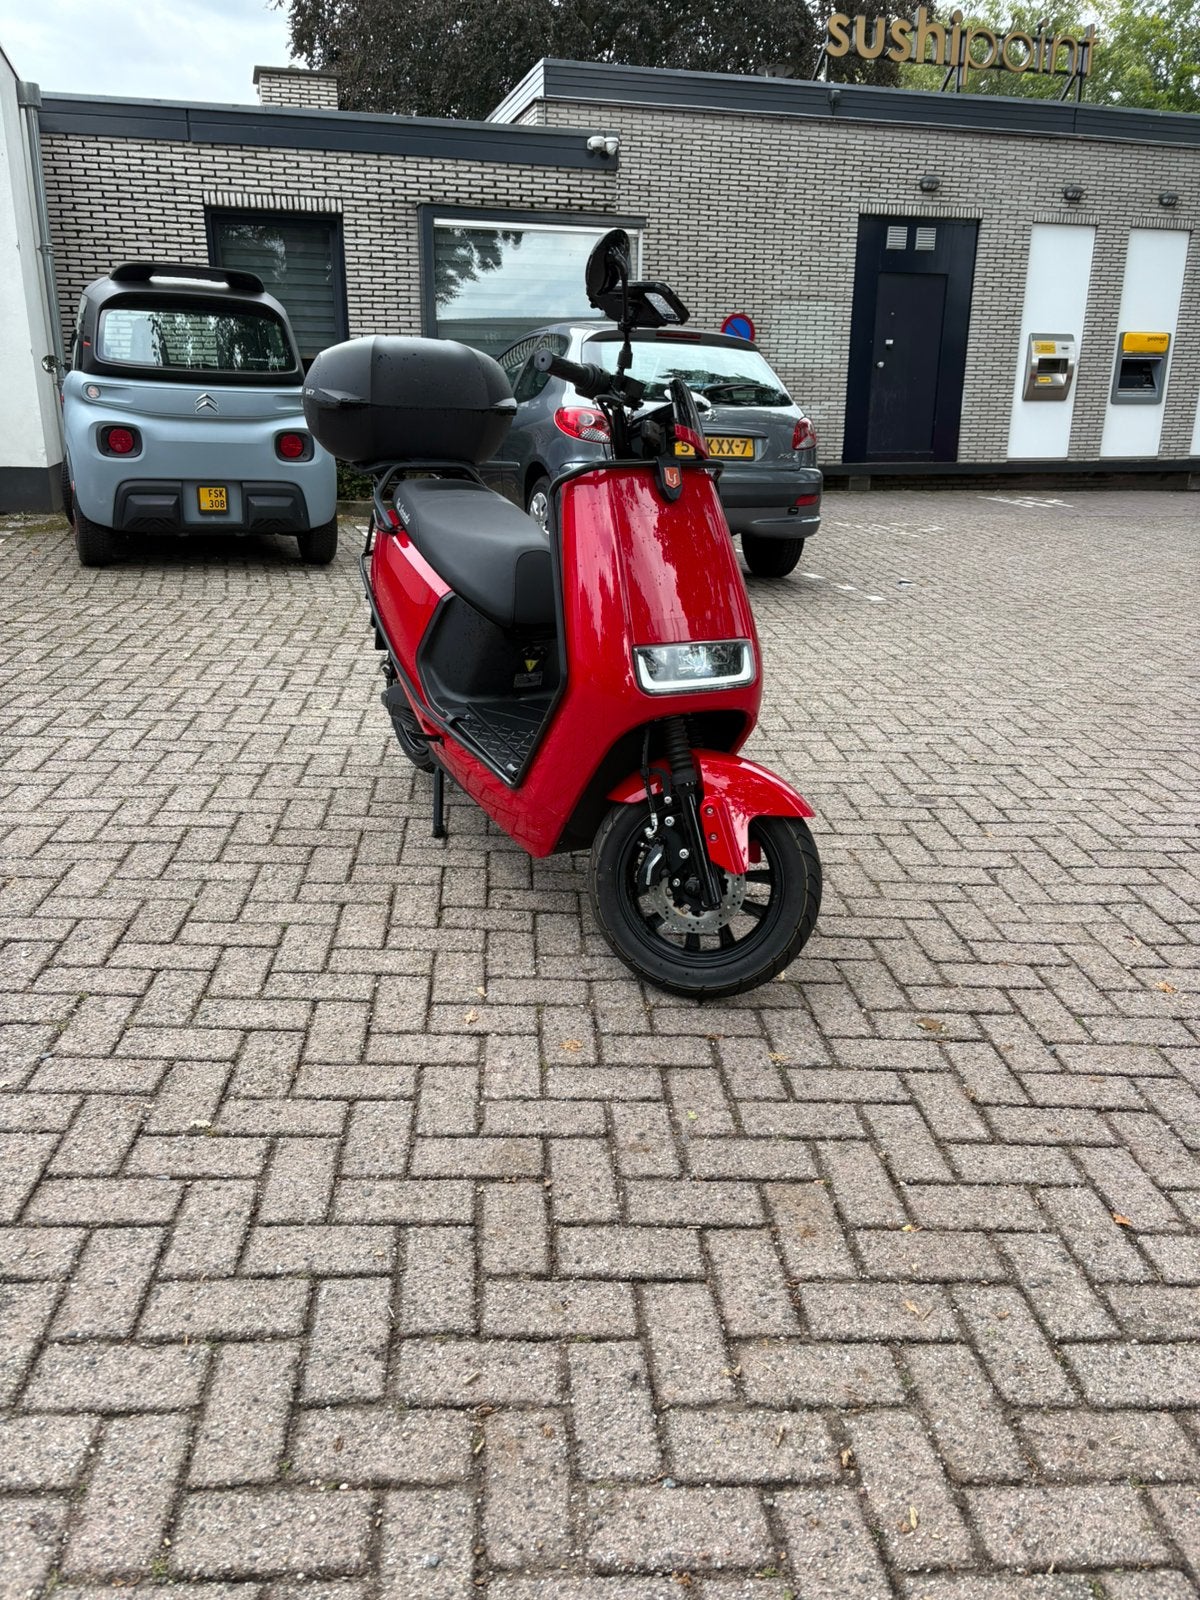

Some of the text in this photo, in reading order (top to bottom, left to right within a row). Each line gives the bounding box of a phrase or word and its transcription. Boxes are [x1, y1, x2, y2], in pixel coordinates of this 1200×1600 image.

[825, 6, 1099, 86] sushipoint
[681, 440, 748, 455] 5KXX-7
[208, 489, 224, 498] FSK
[209, 500, 225, 508] 308
